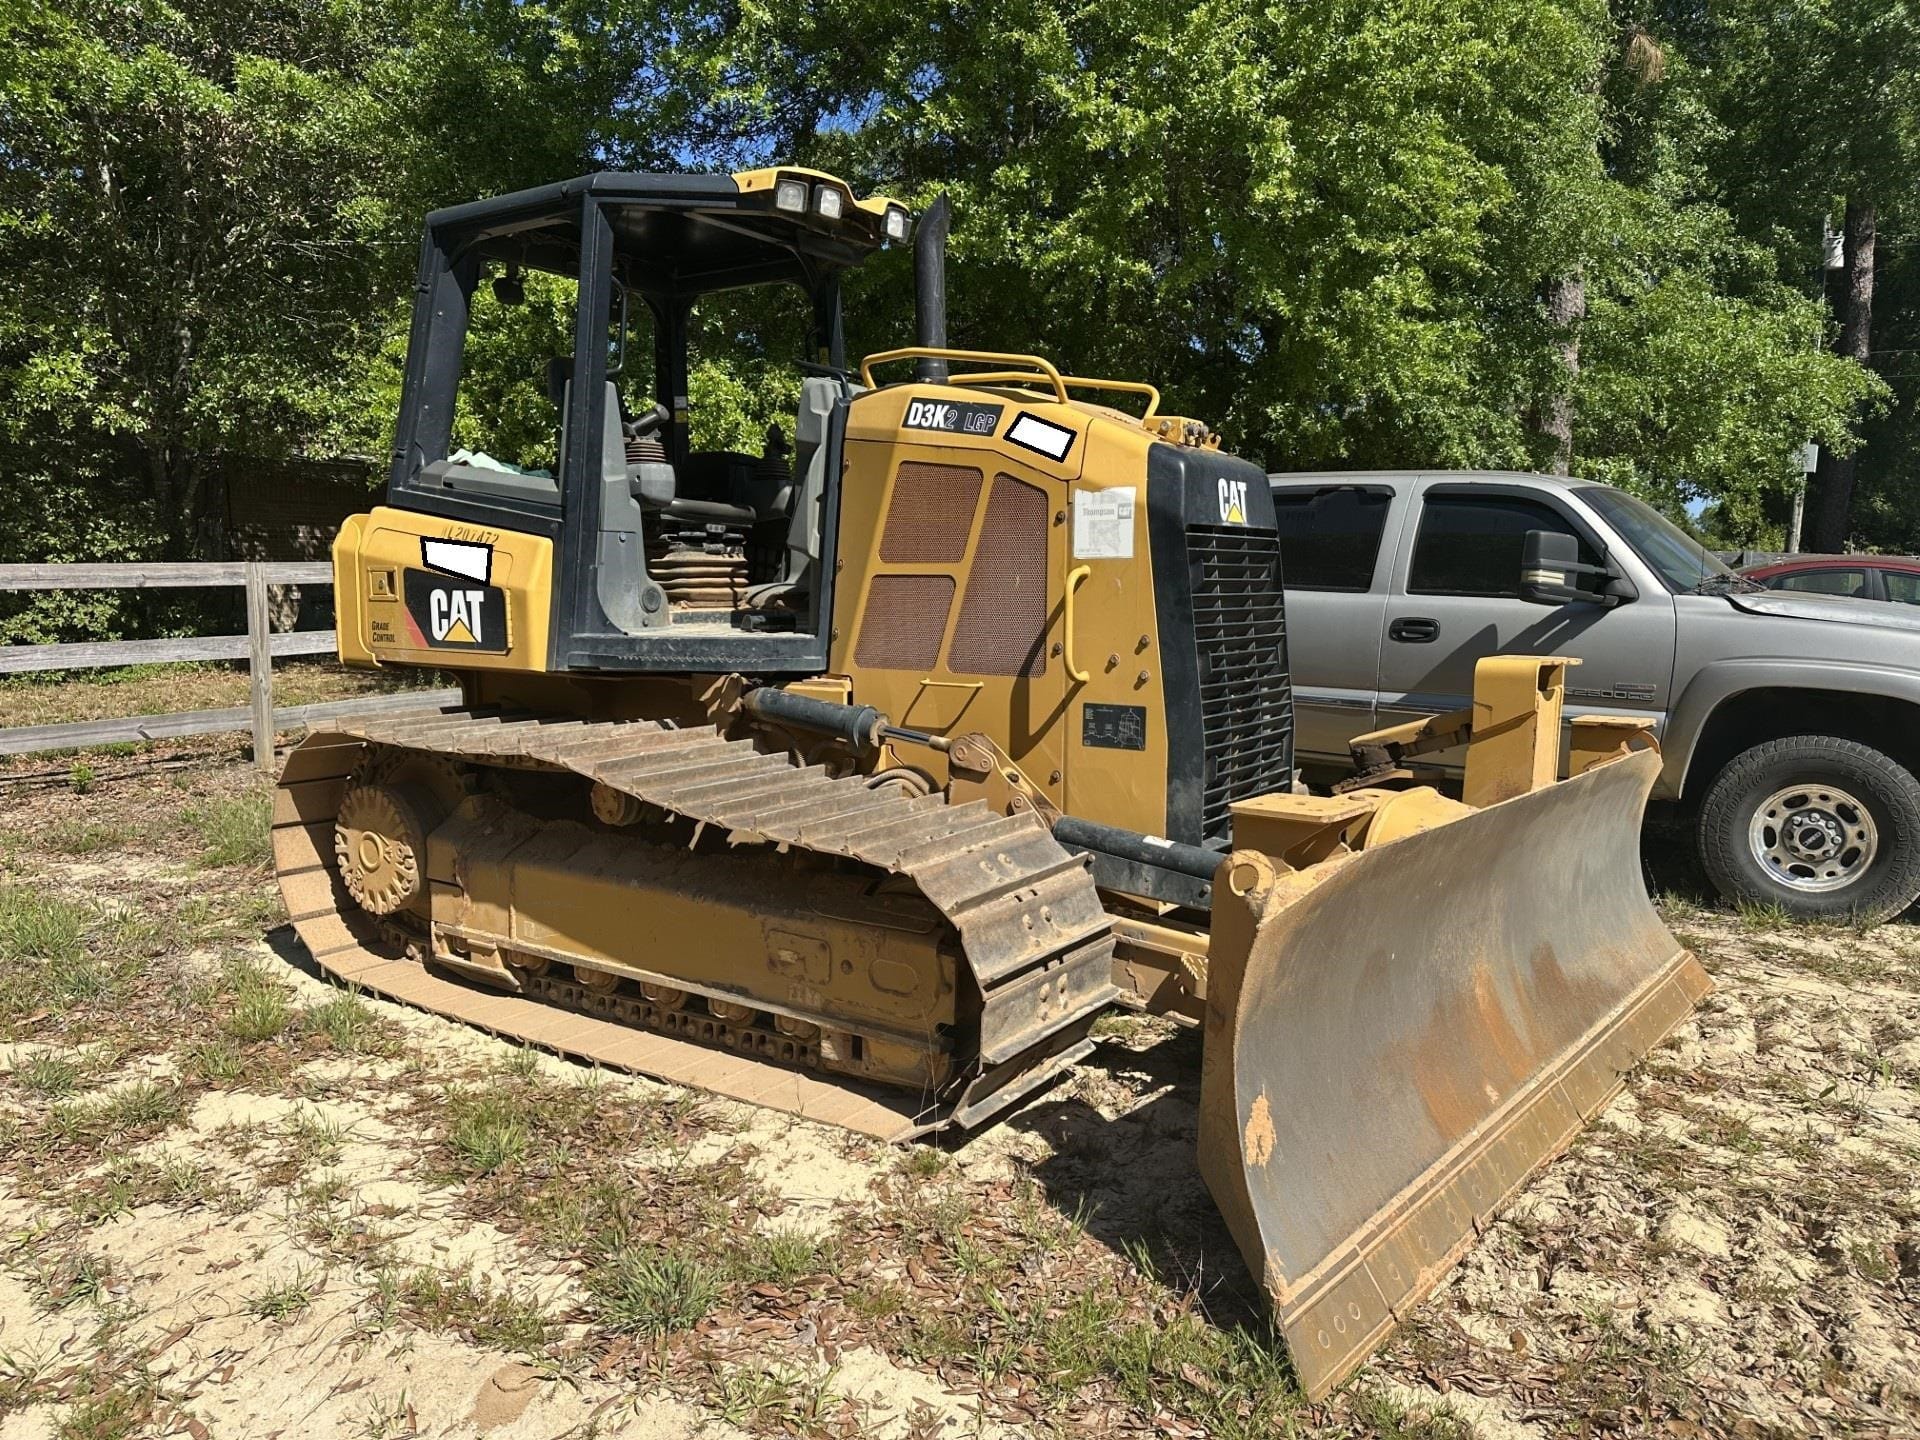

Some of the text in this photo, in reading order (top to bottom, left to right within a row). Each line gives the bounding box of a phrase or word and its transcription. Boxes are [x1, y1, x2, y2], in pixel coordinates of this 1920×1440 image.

[963, 412, 997, 433] LGP
[1217, 478, 1247, 524] CAT
[429, 588, 485, 643] CAT
